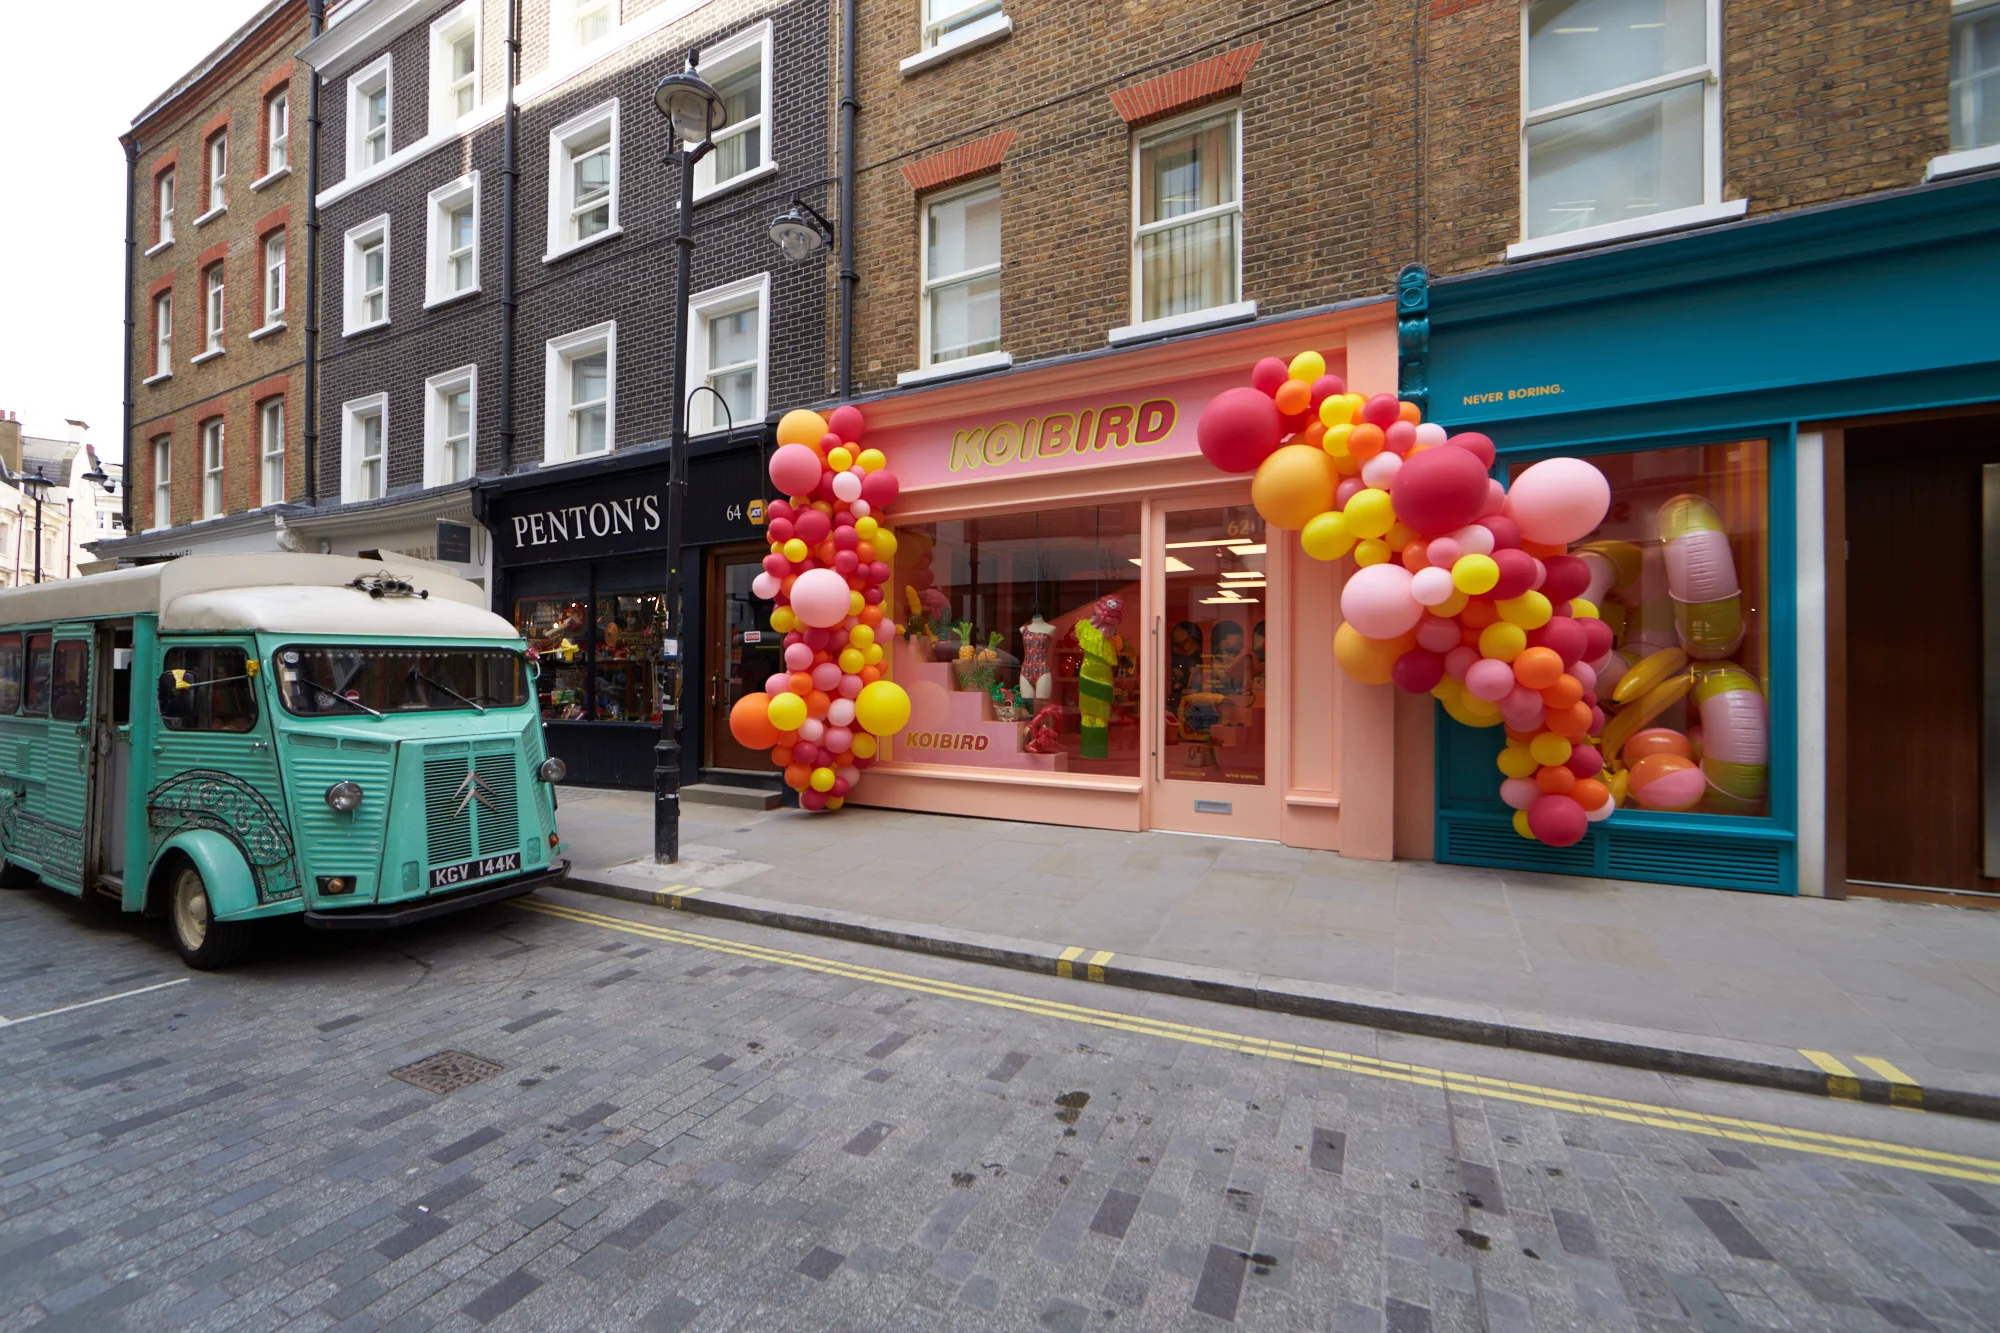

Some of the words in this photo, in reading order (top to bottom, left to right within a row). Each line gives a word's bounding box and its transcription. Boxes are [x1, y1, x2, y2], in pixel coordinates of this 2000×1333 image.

[1463, 391, 1504, 406] NEVER
[1508, 383, 1565, 400] BORING.
[949, 397, 1179, 473] KOIBIRD
[511, 494, 661, 548] PENTON'S
[726, 503, 742, 521] 64
[1227, 519, 1249, 536] 62
[905, 731, 989, 752] KOIBIRD
[435, 864, 469, 886] KGV
[479, 854, 516, 876] 144K
